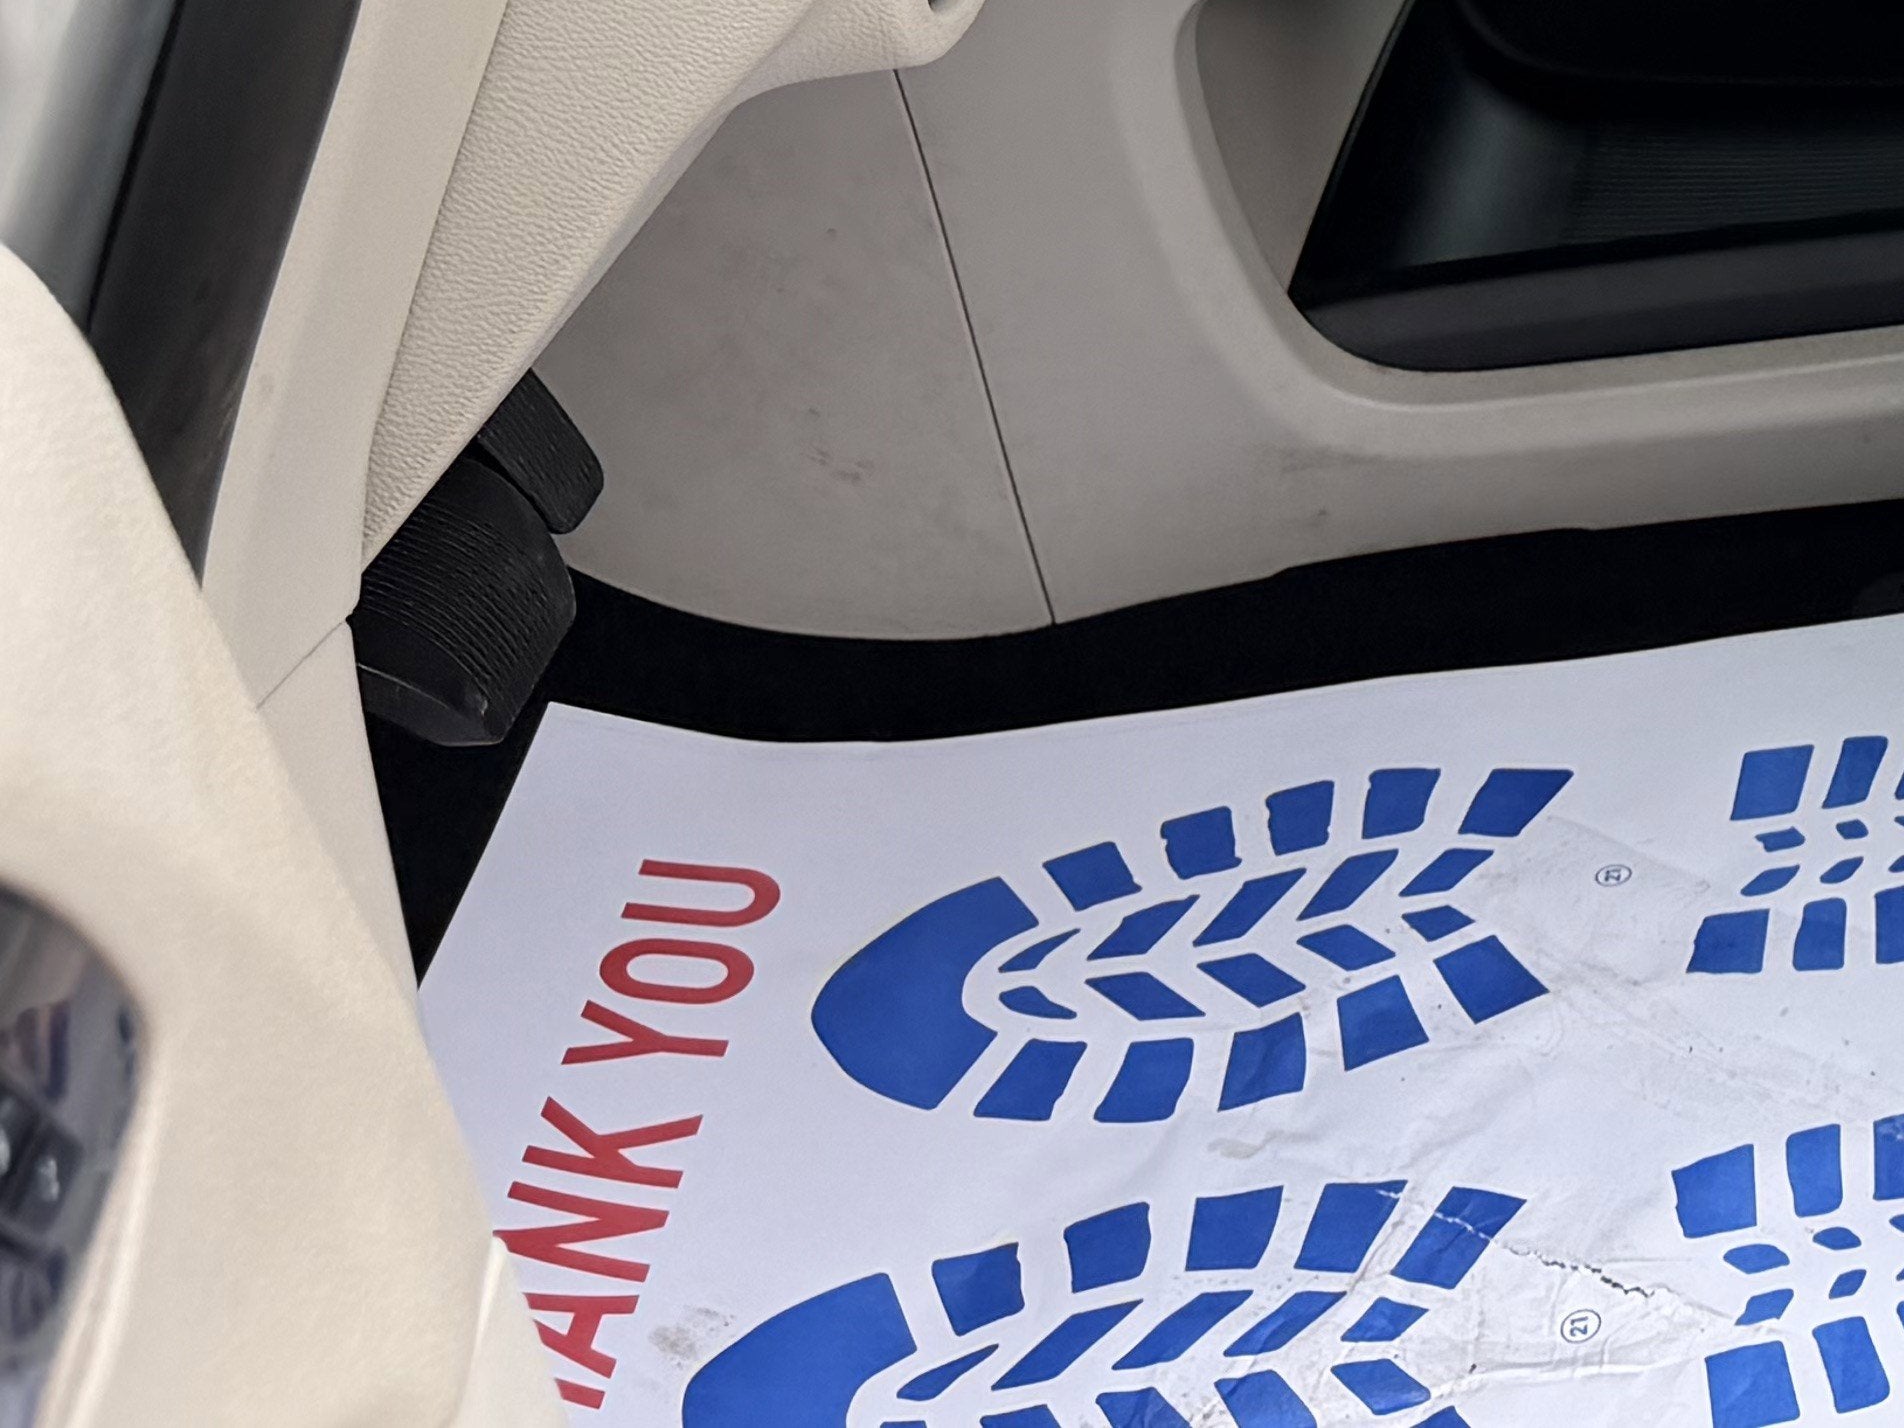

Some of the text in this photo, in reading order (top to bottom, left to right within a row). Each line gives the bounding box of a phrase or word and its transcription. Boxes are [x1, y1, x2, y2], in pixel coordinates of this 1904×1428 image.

[1603, 867, 1621, 883] 21
[492, 858, 782, 1410] ANK YOU
[1571, 1315, 1590, 1336] 21
